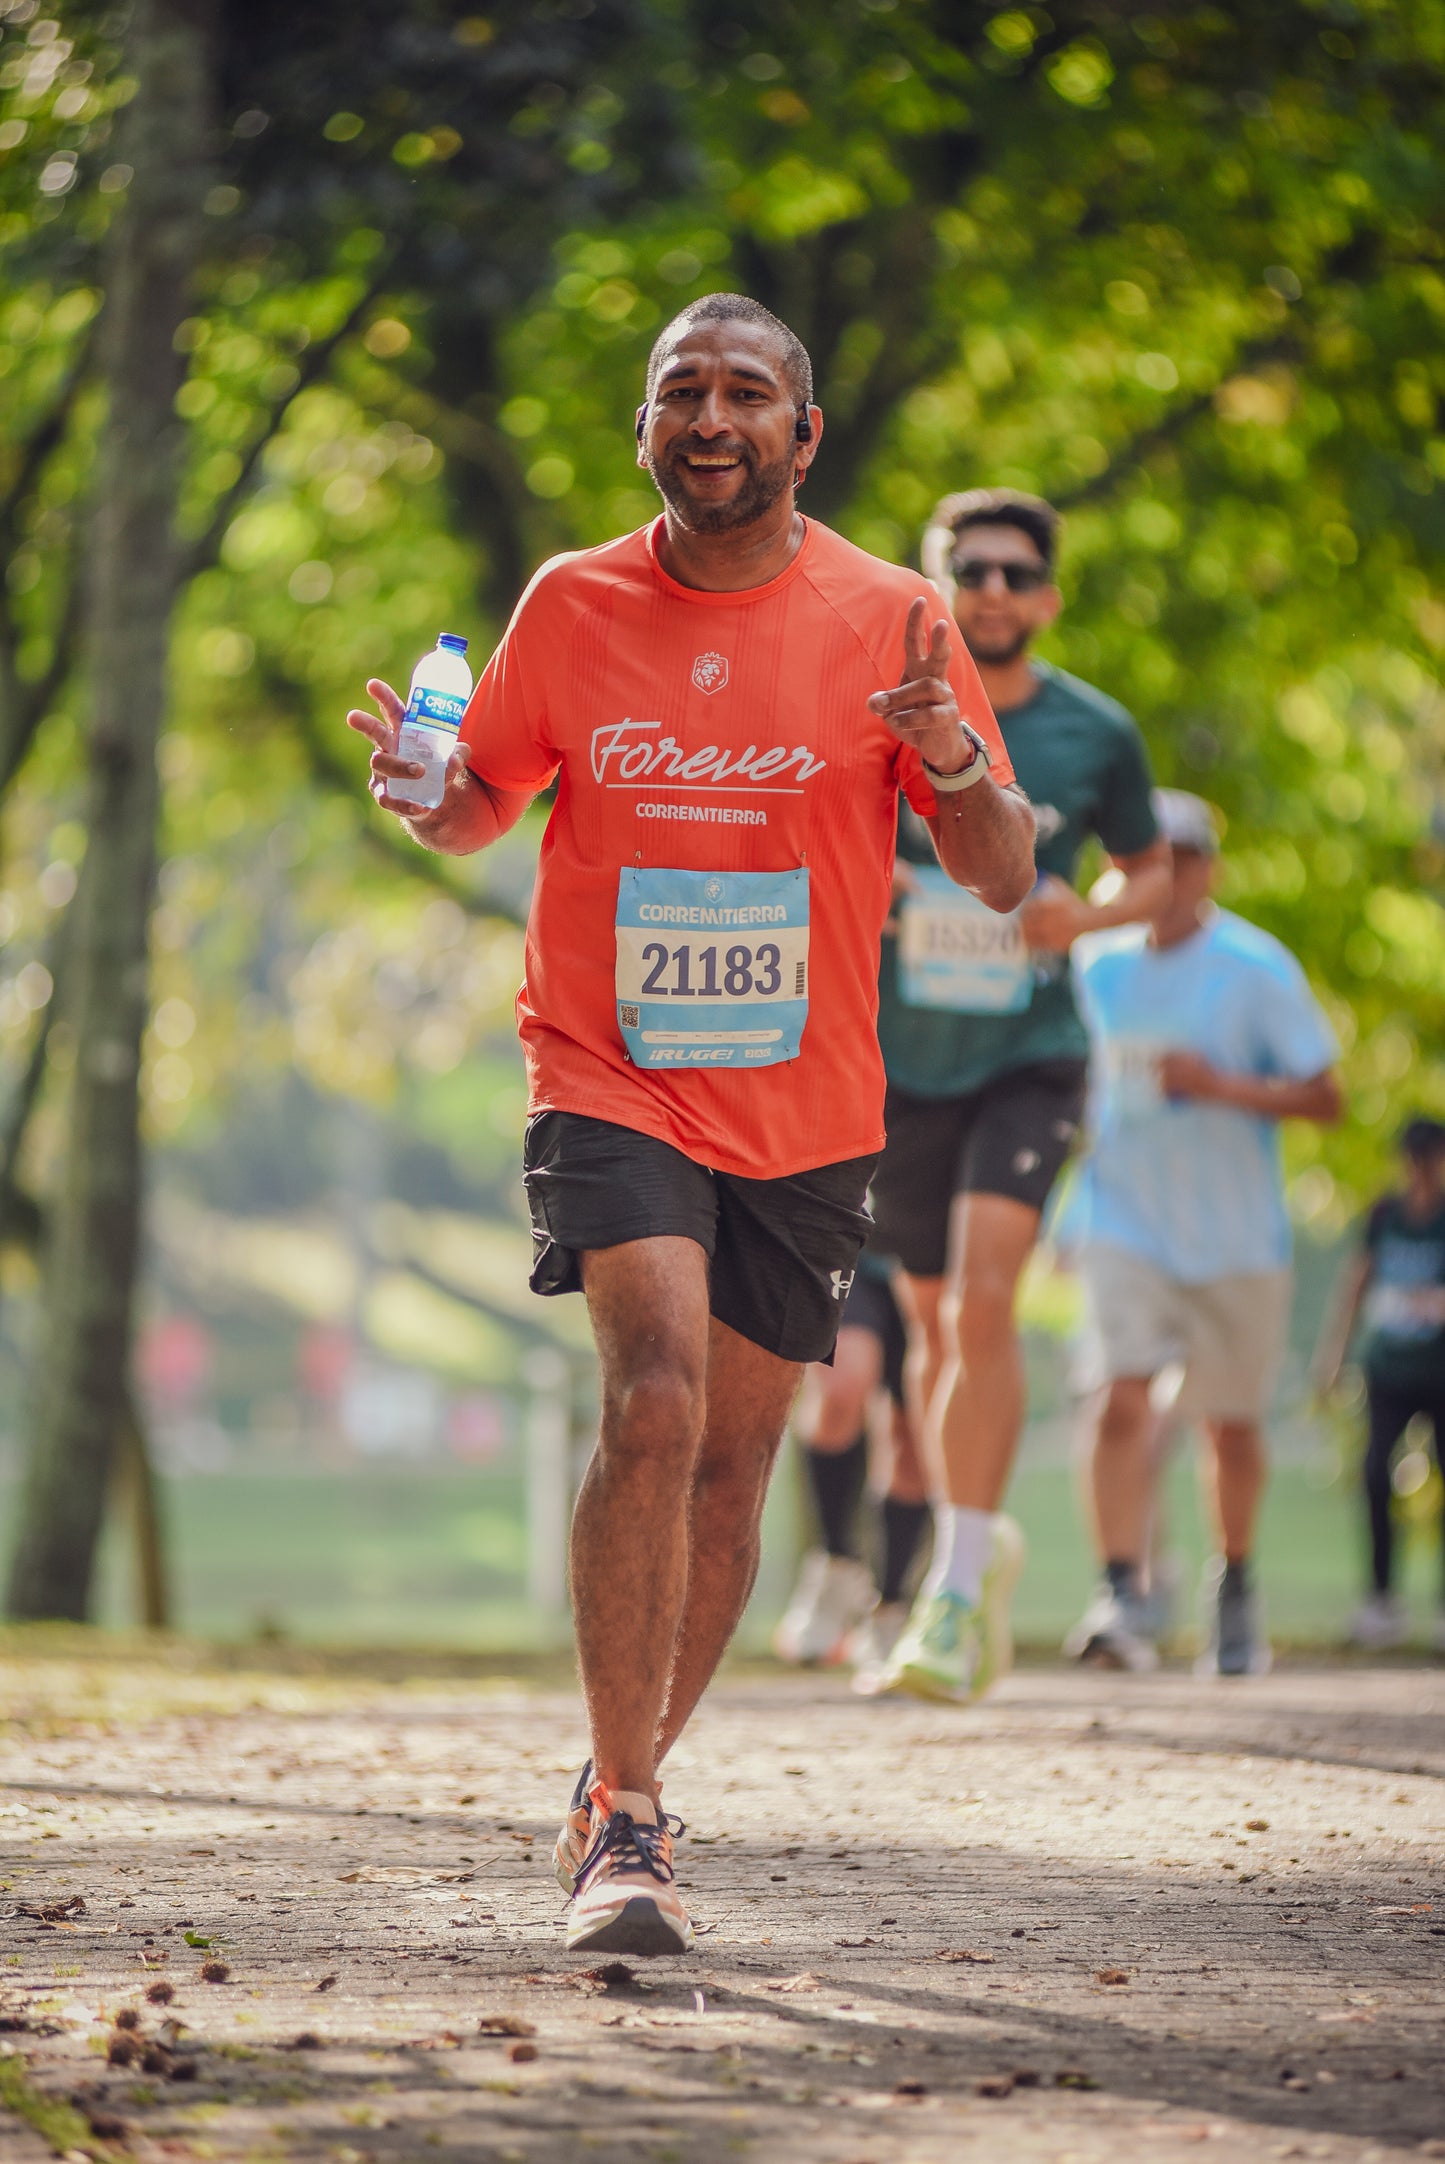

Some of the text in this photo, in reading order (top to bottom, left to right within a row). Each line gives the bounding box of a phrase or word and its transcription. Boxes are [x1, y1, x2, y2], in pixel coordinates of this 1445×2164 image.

[590, 717, 827, 783] Forever
[635, 803, 767, 825] CORREMITIERRA
[639, 904, 787, 924] CORREMITIERRA
[641, 943, 782, 996] 21183
